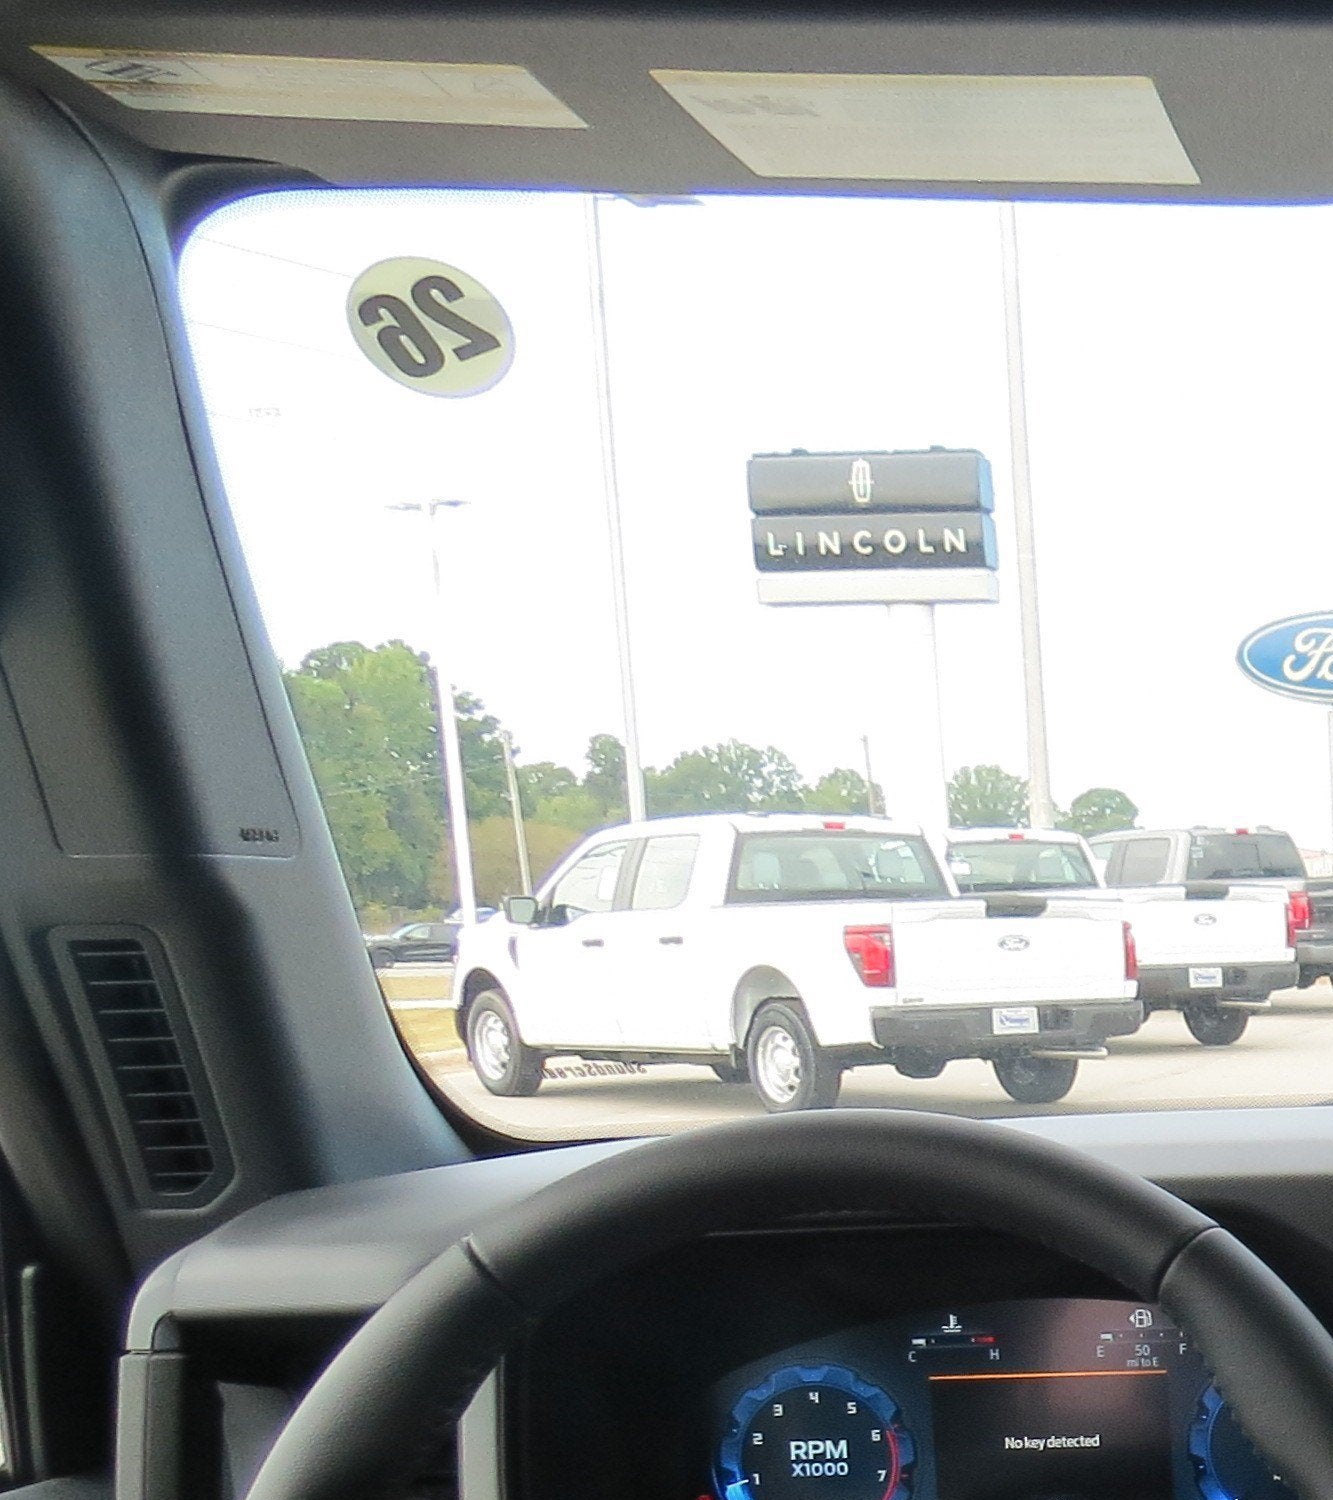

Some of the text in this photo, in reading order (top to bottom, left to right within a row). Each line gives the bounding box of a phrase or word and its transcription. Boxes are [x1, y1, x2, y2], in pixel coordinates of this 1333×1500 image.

[766, 527, 968, 556] LINCOLN
[989, 1348, 1000, 1361] H
[1096, 1346, 1105, 1358] E
[1134, 1344, 1151, 1357] 50
[1178, 1342, 1187, 1355] F
[908, 1350, 917, 1363] C
[1141, 1357, 1151, 1367] to
[808, 1391, 820, 1404] 4
[772, 1403, 784, 1417] 3
[846, 1401, 857, 1414] 5
[752, 1432, 764, 1446] 2
[871, 1429, 881, 1442] 6
[1004, 1434, 1100, 1451] No key detected
[789, 1438, 849, 1461] RPM
[791, 1461, 849, 1478] X1000
[877, 1469, 887, 1482] 7
[752, 1473, 761, 1485] 1
